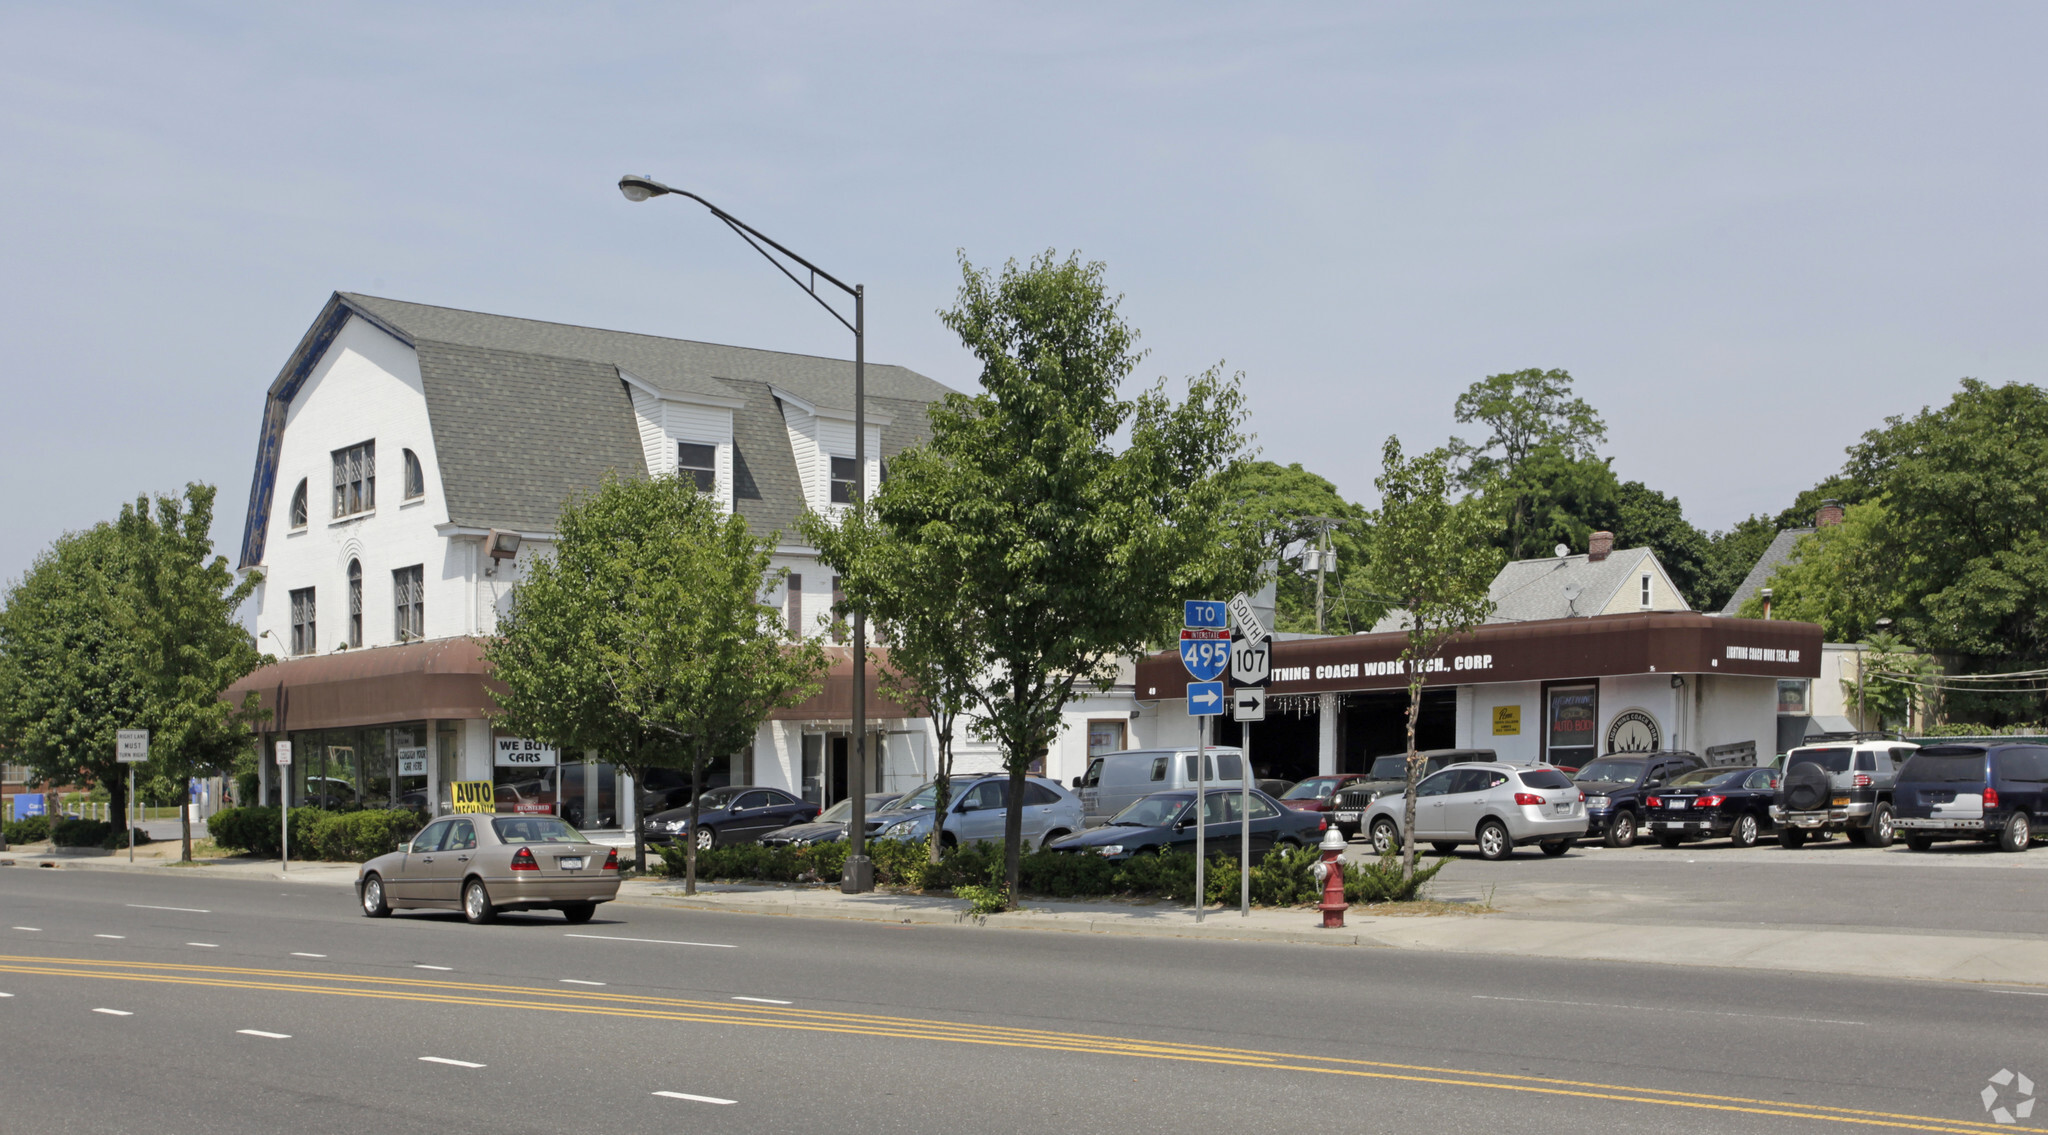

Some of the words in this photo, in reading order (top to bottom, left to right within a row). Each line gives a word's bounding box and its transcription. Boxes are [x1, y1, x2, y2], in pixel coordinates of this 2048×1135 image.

[1195, 606, 1215, 622] TO
[1233, 599, 1262, 641] SOUTH
[1191, 631, 1220, 639] INTERSTATE
[1184, 643, 1227, 668] 495
[1236, 649, 1265, 673] 107
[1315, 663, 1359, 679] COACH
[1364, 660, 1405, 677] WORK
[1454, 654, 1493, 671] CORP.
[1553, 719, 1573, 732] AUTO
[1609, 714, 1631, 742] LIGHTNING
[1630, 713, 1650, 724] COACH
[1647, 722, 1658, 742] WORK
[500, 741, 520, 751] WE
[524, 741, 550, 751] BUY
[400, 751, 416, 760] CONSIGN
[416, 750, 426, 760] YOUR
[508, 753, 541, 763] CARS
[404, 761, 412, 771] CAR
[413, 761, 423, 771] HERE
[457, 782, 491, 803] AUTO
[455, 803, 494, 814] MECHANIC
